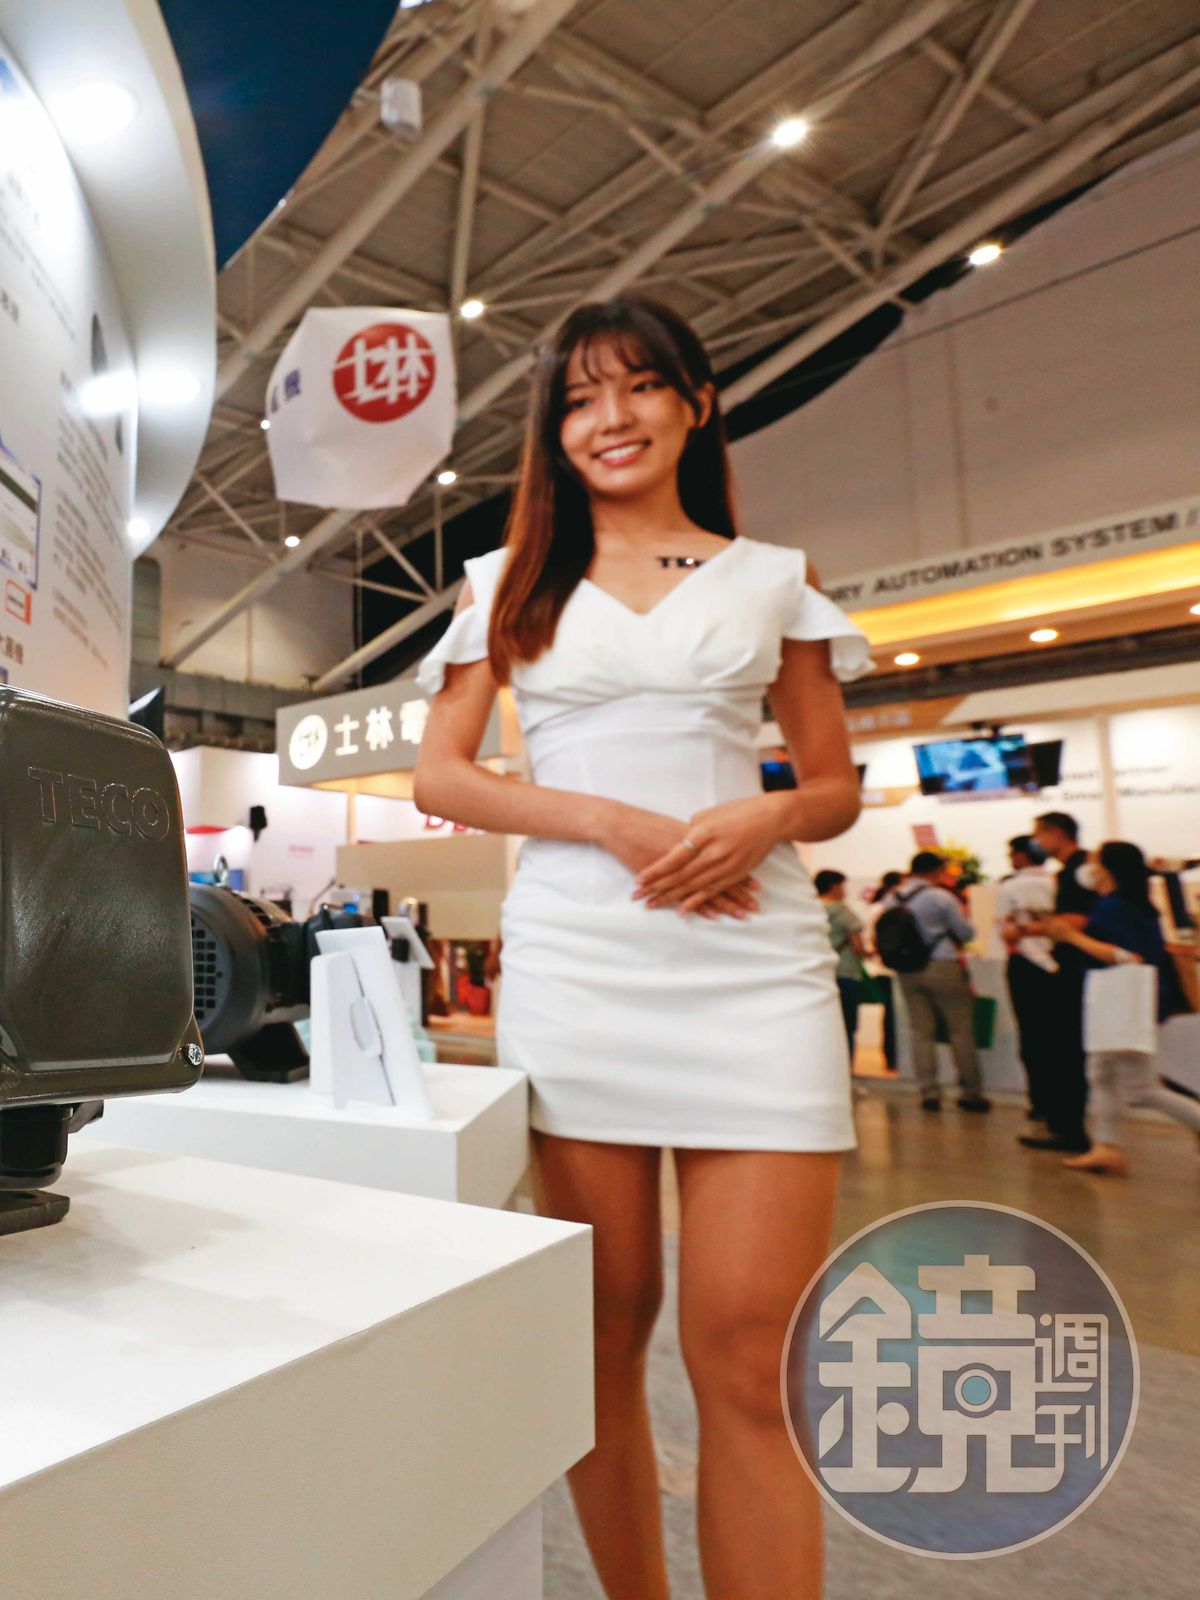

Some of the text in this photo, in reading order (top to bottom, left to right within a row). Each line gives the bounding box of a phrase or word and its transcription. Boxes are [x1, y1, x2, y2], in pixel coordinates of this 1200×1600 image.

[874, 543, 1043, 593] AUTOMATION
[1051, 512, 1177, 556] SYSTEM
[28, 766, 170, 841] TECO
